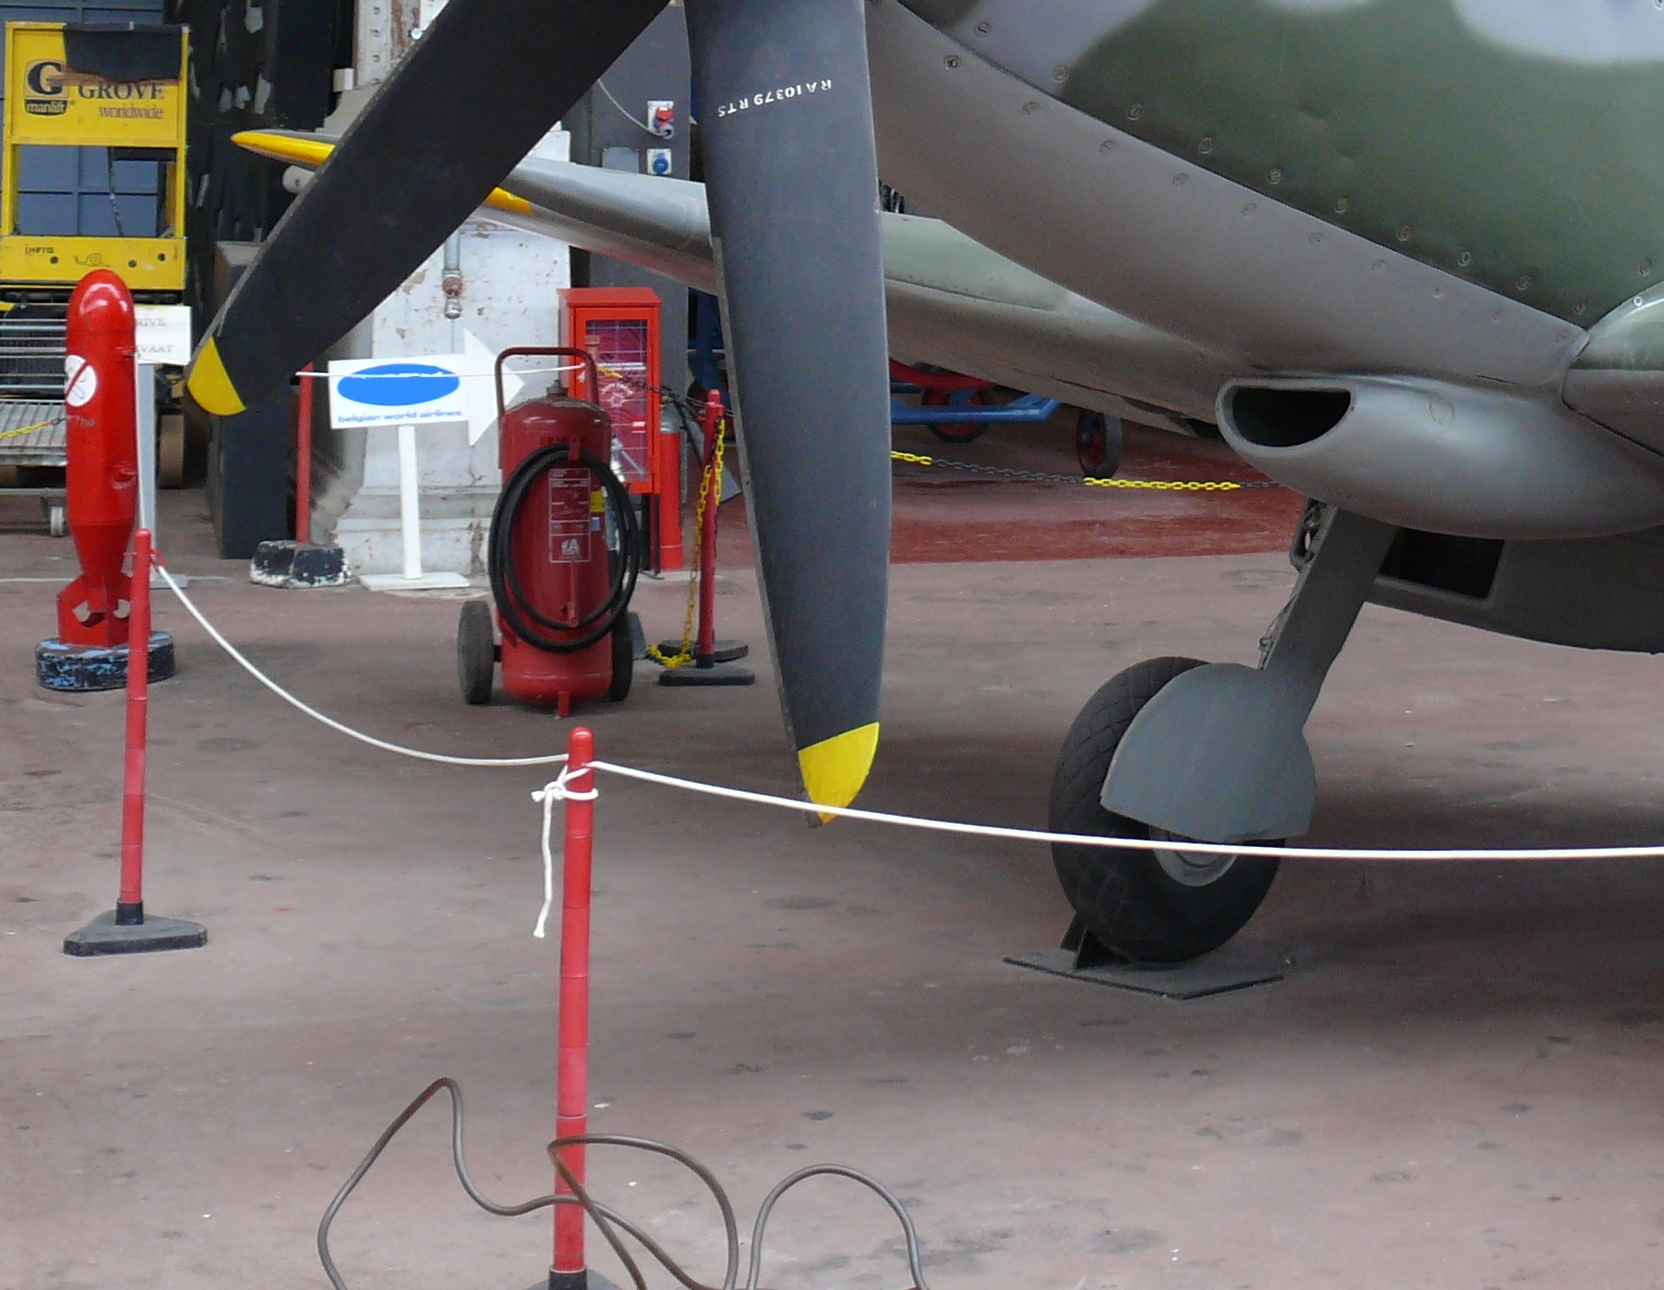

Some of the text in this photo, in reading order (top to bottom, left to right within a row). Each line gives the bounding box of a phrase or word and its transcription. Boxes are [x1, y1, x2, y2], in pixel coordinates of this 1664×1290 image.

[77, 81, 165, 100] GROVE
[98, 103, 164, 120] worldwide
[337, 408, 462, 423] belgian world airlines
